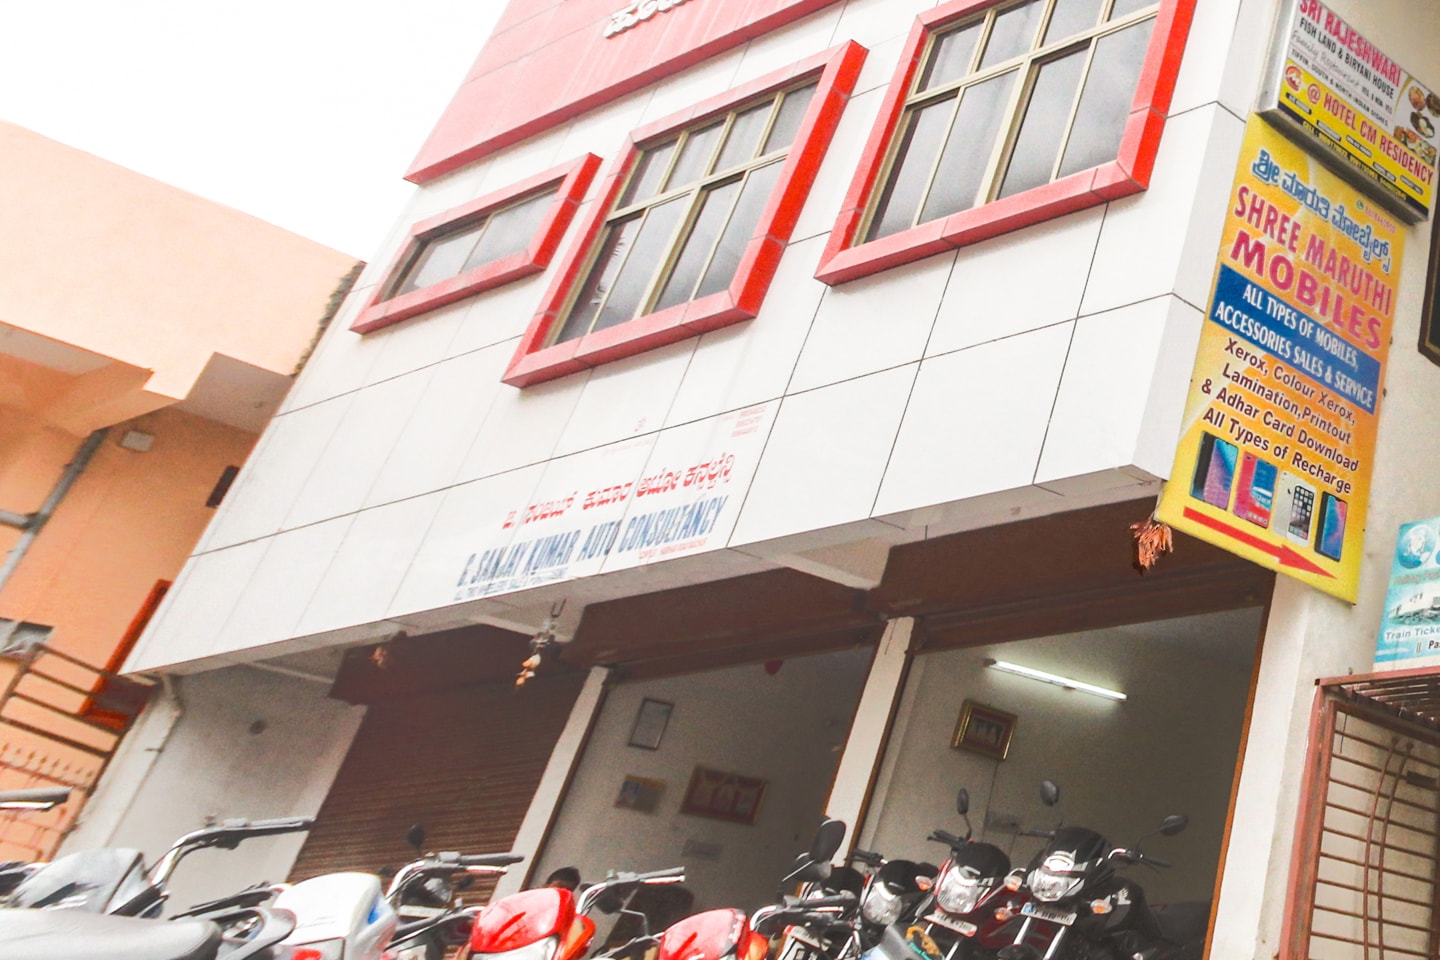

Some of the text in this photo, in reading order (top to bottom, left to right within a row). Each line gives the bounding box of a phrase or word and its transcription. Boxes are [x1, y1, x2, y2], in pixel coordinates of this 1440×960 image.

[1299, 17, 1394, 100] FISH LAND & BIRYANI HOUSE
[1324, 12, 1402, 87] RAJESHWARI
[1251, 148, 1280, 184] ಶ್ರೀ
[1307, 83, 1322, 105] @
[1323, 92, 1357, 131] HOTEL
[1360, 120, 1377, 144] CM
[1379, 135, 1434, 186] RESIDENCY
[1230, 230, 1382, 350] MOBILES
[1234, 185, 1302, 254] SHREE
[1305, 234, 1392, 316] MARUTHI
[1215, 301, 1373, 409] ACCESSORIES SALES & SERVICE
[1243, 284, 1359, 371] ALL TYPES OF MOBILES,
[1201, 378, 1359, 472] & Adhar Card Download
[1224, 337, 1356, 426] Xerox, Colour Xerox,
[1202, 407, 1352, 494] All Types of Recharge
[523, 529, 580, 576] KUMAR
[576, 519, 623, 561] AUTO
[618, 495, 729, 553] CONSULTANCY
[1385, 628, 1413, 641] Train
